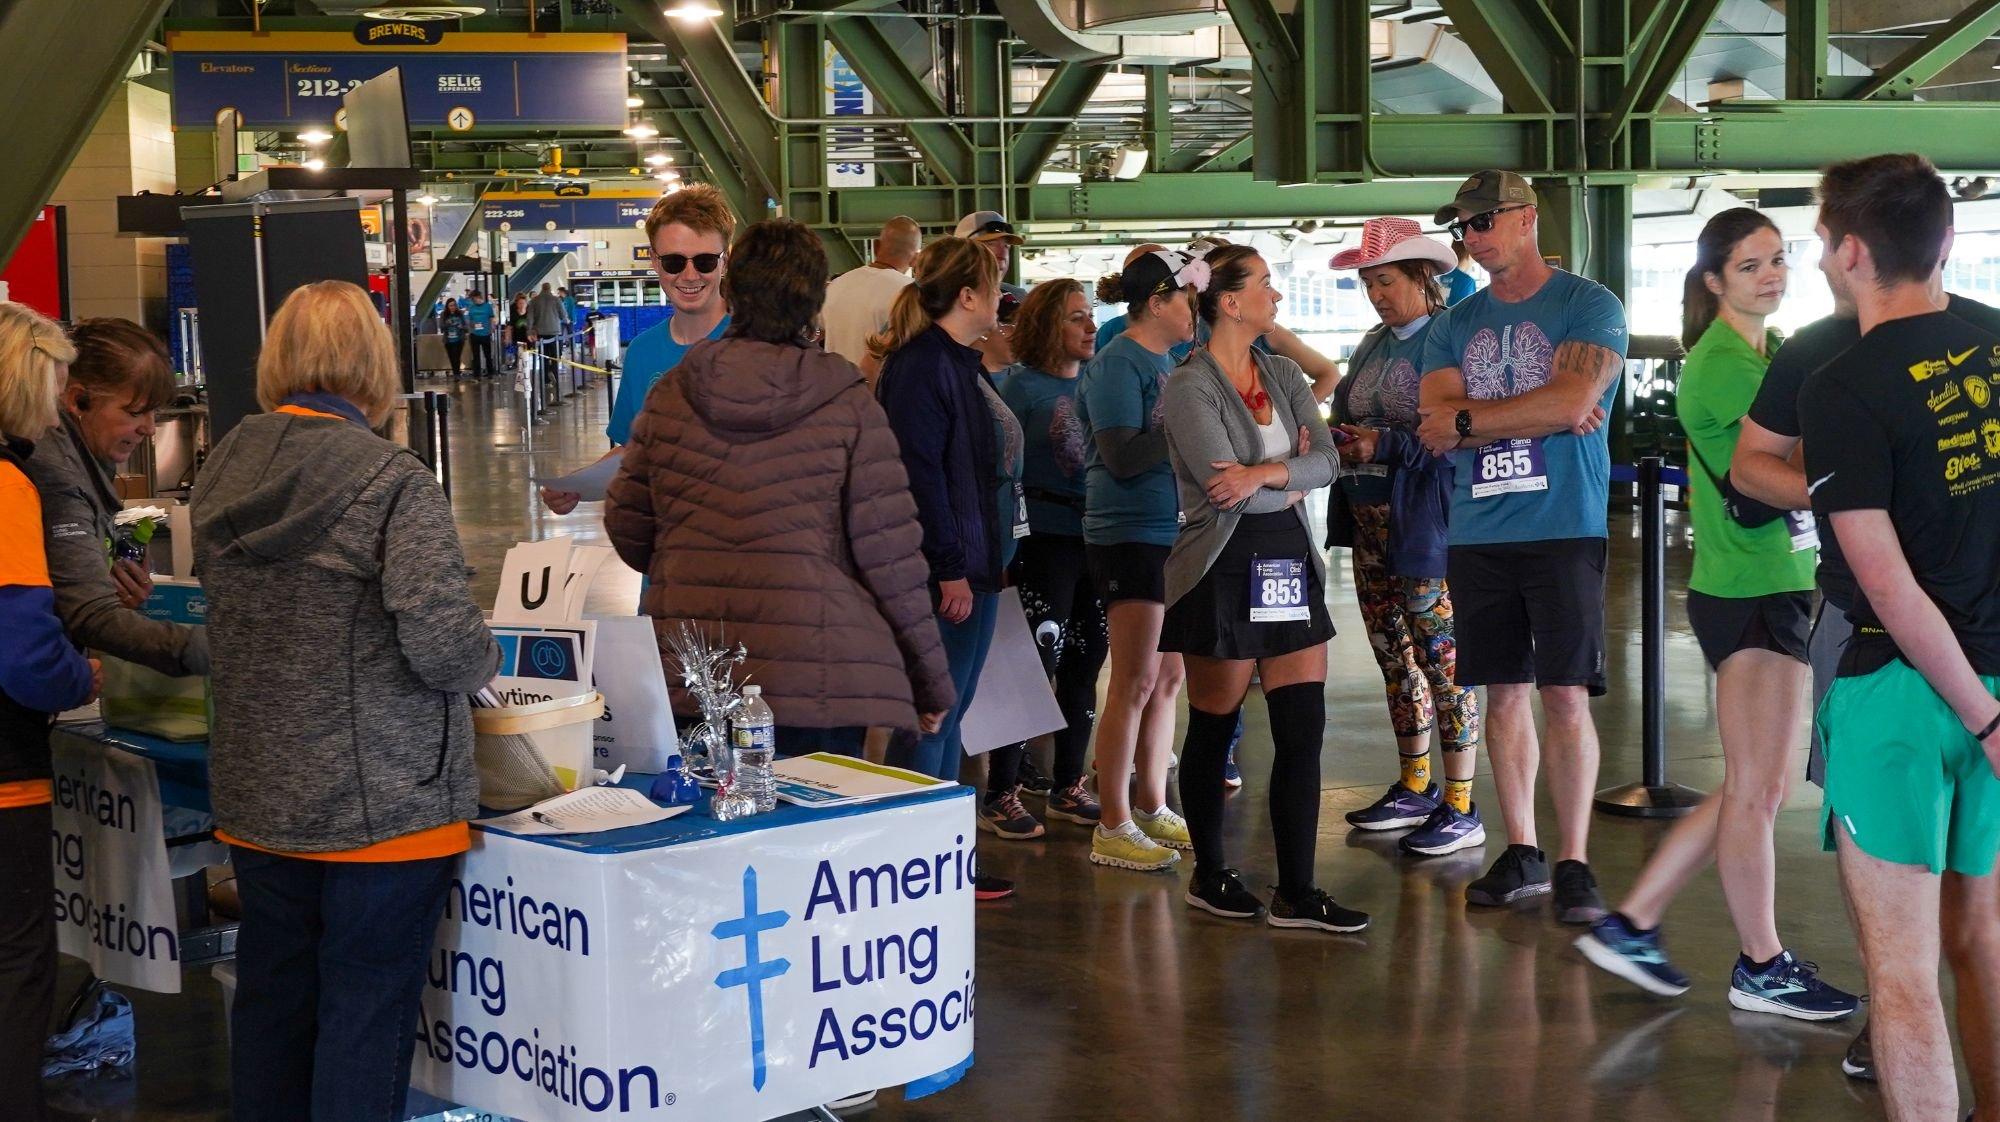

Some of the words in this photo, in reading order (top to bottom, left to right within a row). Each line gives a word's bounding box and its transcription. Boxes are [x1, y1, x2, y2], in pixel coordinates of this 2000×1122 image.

[369, 23, 425, 41] BREWERS
[200, 62, 254, 74] Elevators
[297, 79, 367, 97] 212-2
[438, 76, 482, 87] SELIG
[1482, 449, 1531, 480] 855
[520, 565, 551, 610] U
[1262, 578, 1301, 605] 853
[812, 925, 939, 993] Lung
